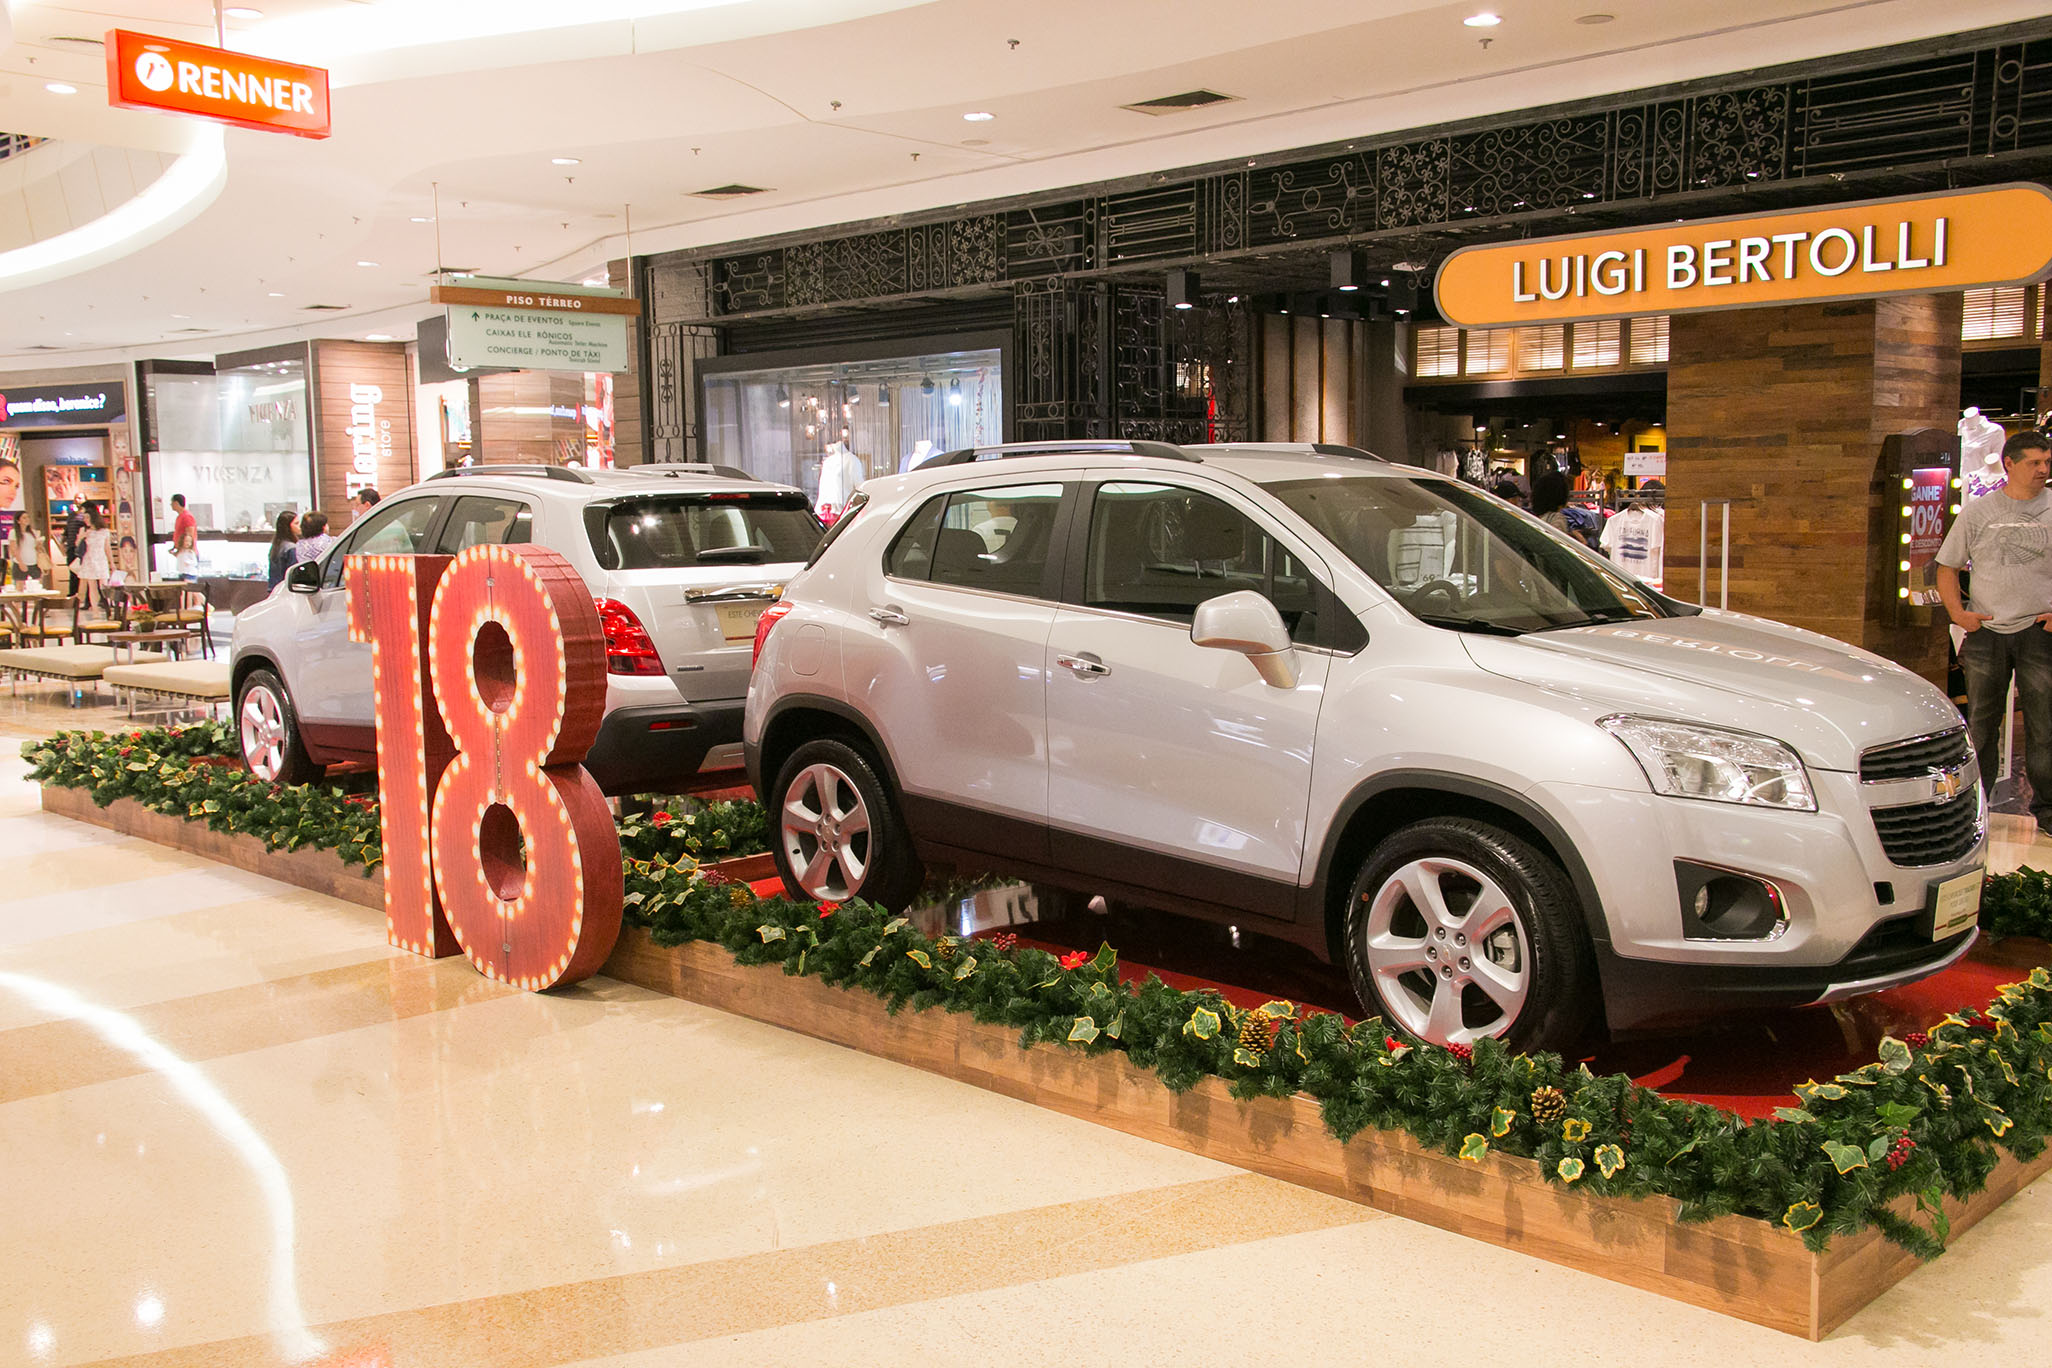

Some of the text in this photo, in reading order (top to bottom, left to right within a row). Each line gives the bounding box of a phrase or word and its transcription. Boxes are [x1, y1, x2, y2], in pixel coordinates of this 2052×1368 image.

[178, 61, 314, 114] RENNER
[1513, 217, 1949, 302] LUIGI BERTOLLI
[485, 313, 511, 323] PRAÇA
[514, 315, 525, 323] DE
[527, 316, 564, 325] EVENTOS
[506, 295, 582, 309] PISO TÉRREO
[486, 328, 516, 337] CAIXAS
[487, 346, 533, 355] CONCIERGE
[541, 348, 569, 357] PONTO
[345, 384, 383, 500] Hering
[380, 419, 392, 457] store
[344, 543, 606, 993] 18
